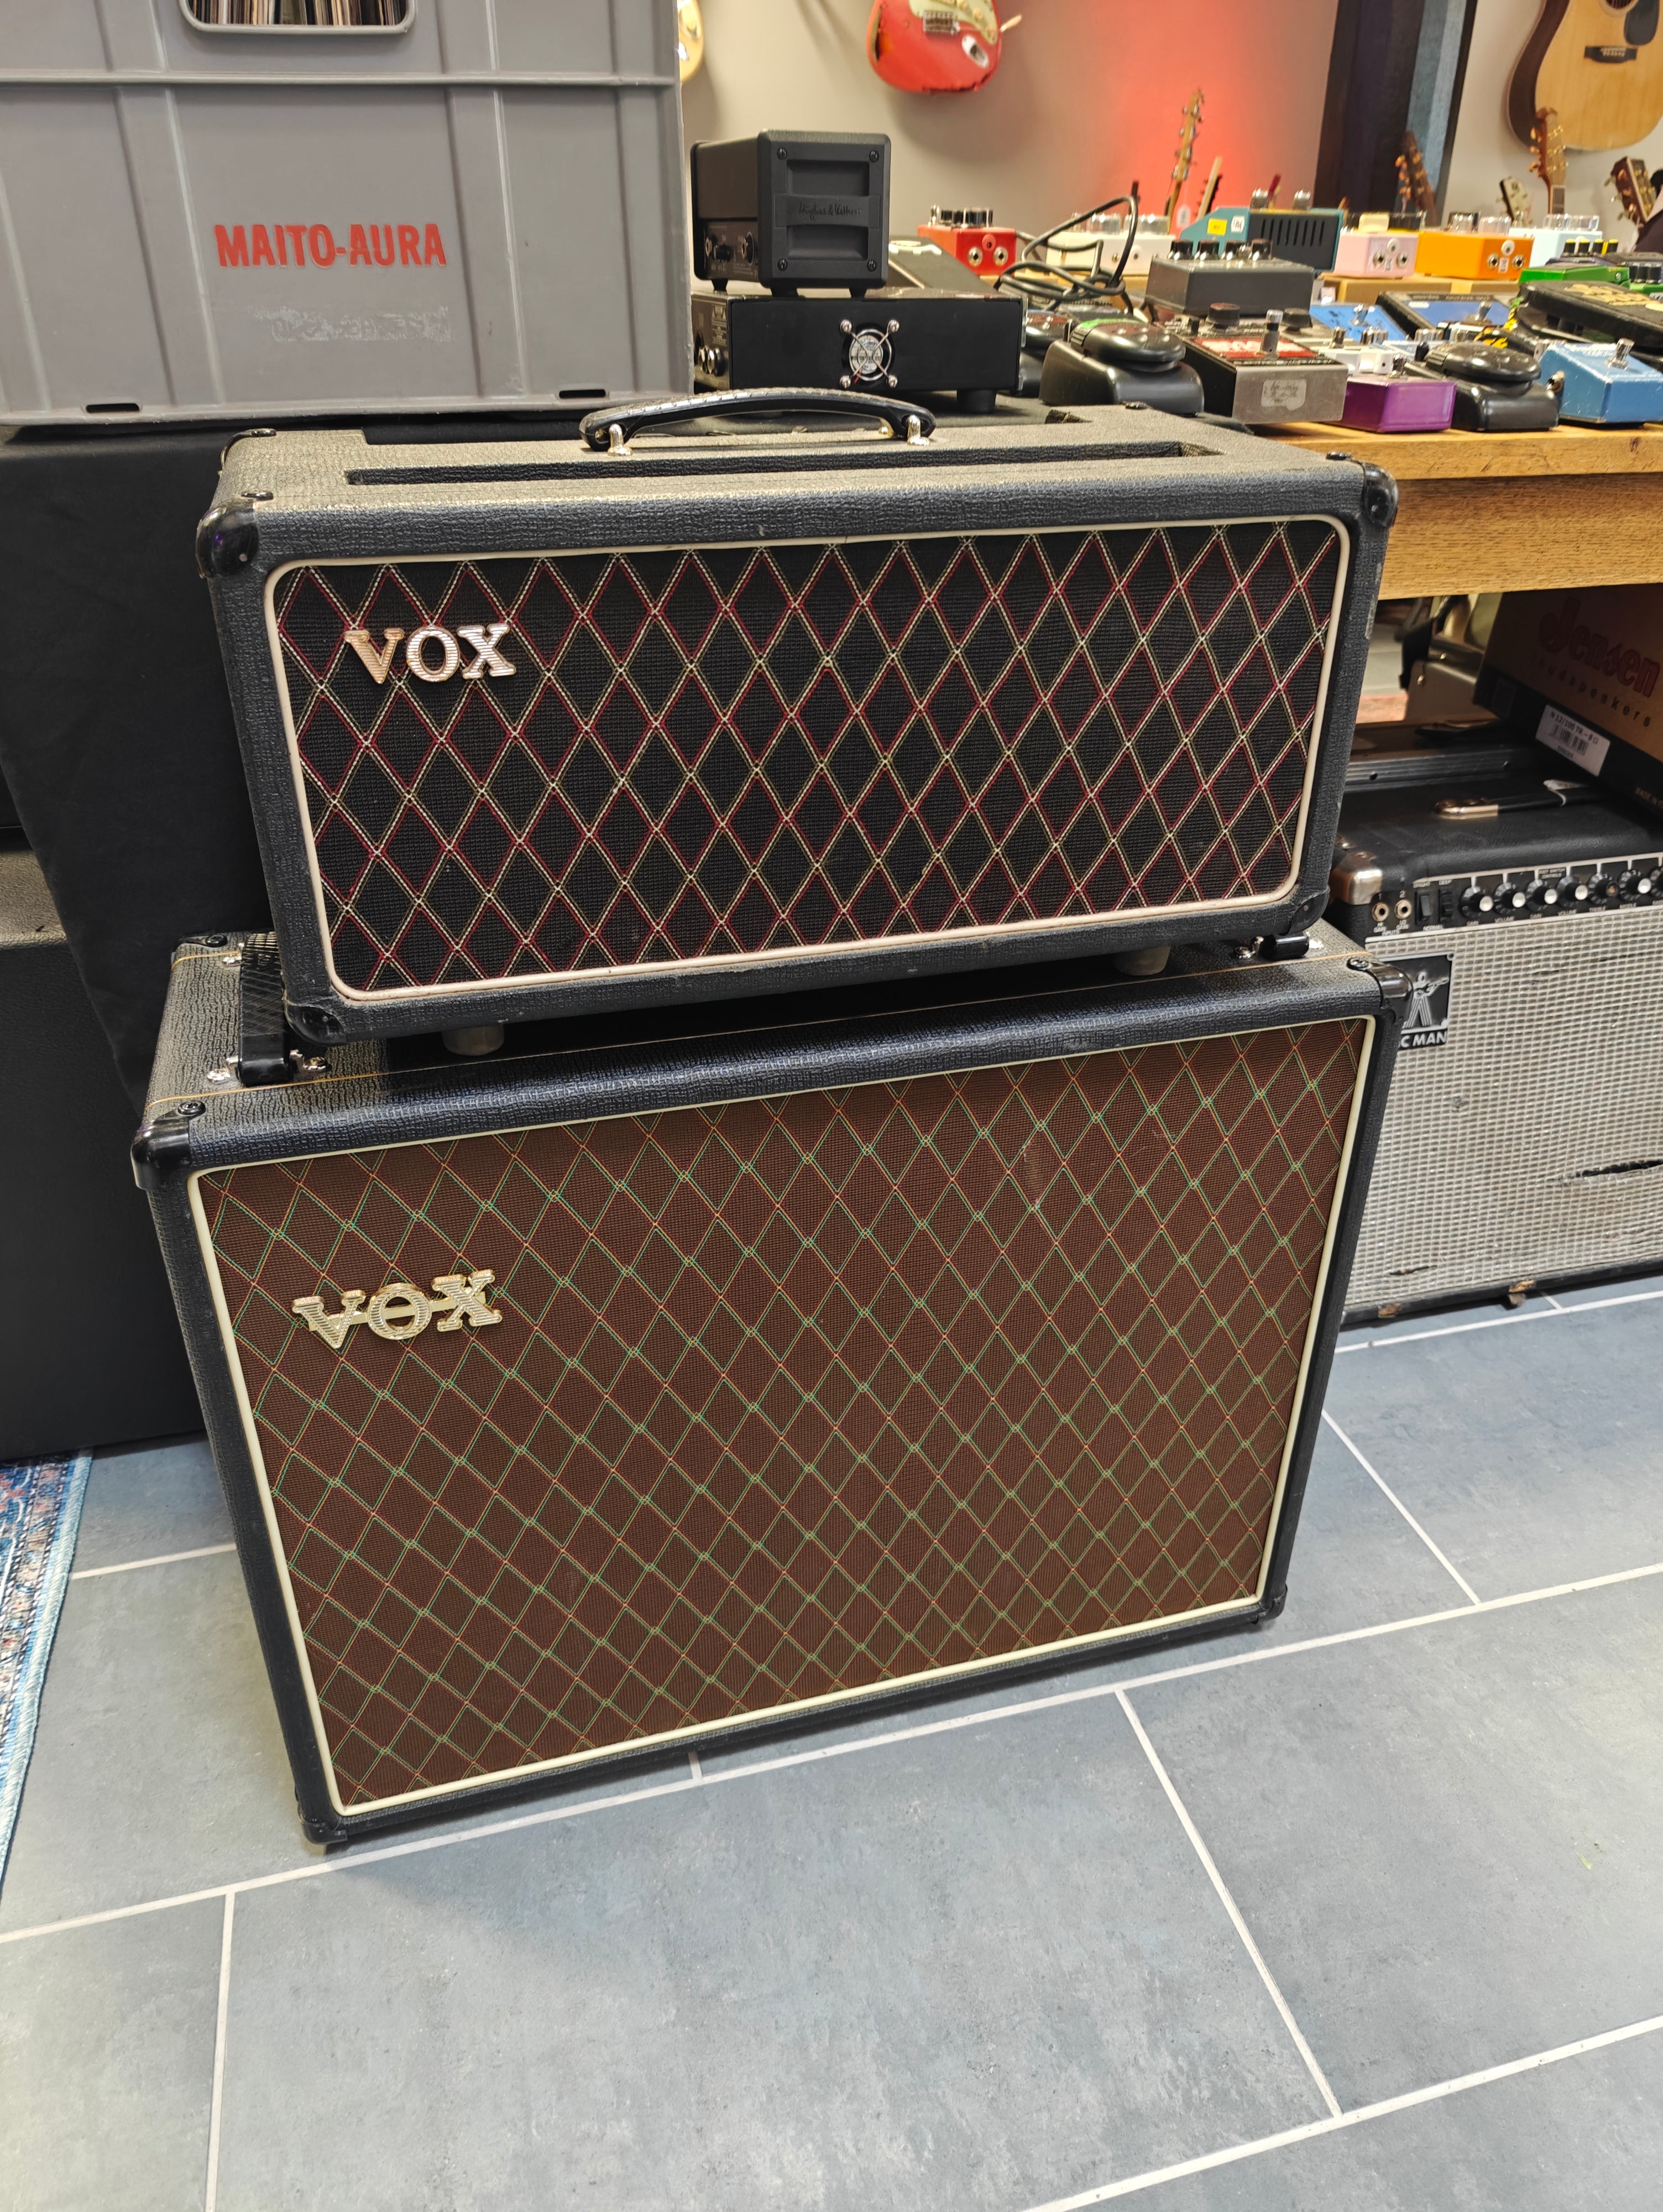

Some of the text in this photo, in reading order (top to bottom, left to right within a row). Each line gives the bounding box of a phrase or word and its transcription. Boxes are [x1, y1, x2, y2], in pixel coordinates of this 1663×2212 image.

[213, 223, 447, 269] MAITO-AURA
[343, 623, 517, 685] VOX
[1539, 596, 1660, 698] Jensen
[1413, 1030, 1448, 1047] MAN
[291, 1269, 503, 1349] VOX
